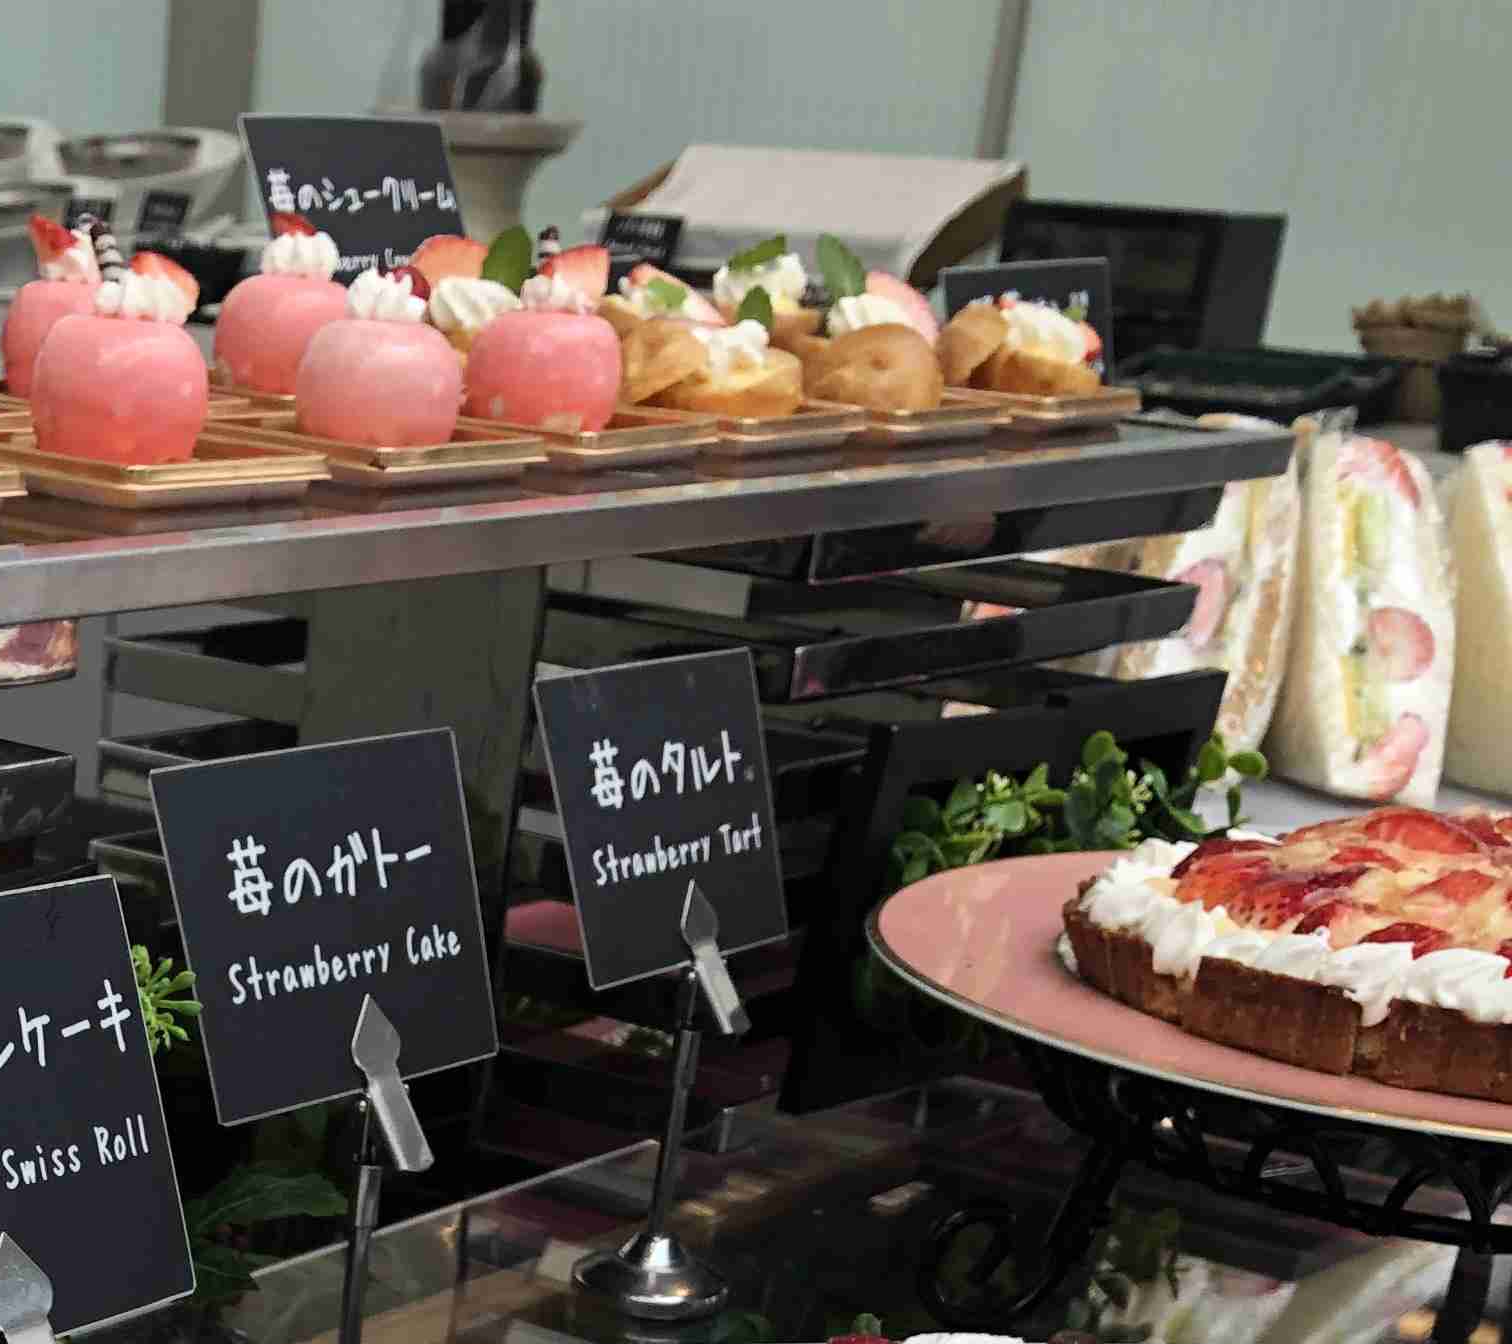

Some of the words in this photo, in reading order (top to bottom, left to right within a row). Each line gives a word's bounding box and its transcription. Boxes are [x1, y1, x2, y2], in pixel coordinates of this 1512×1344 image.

[589, 729, 742, 809] 苺のタルト
[226, 827, 432, 917] 苺のガトー
[592, 834, 711, 887] Strawberry
[718, 811, 762, 855] Tart
[228, 943, 389, 1005] Strawberry
[405, 923, 462, 967] Cake
[0, 1141, 82, 1192] Swiss
[93, 1113, 151, 1167] Roll
